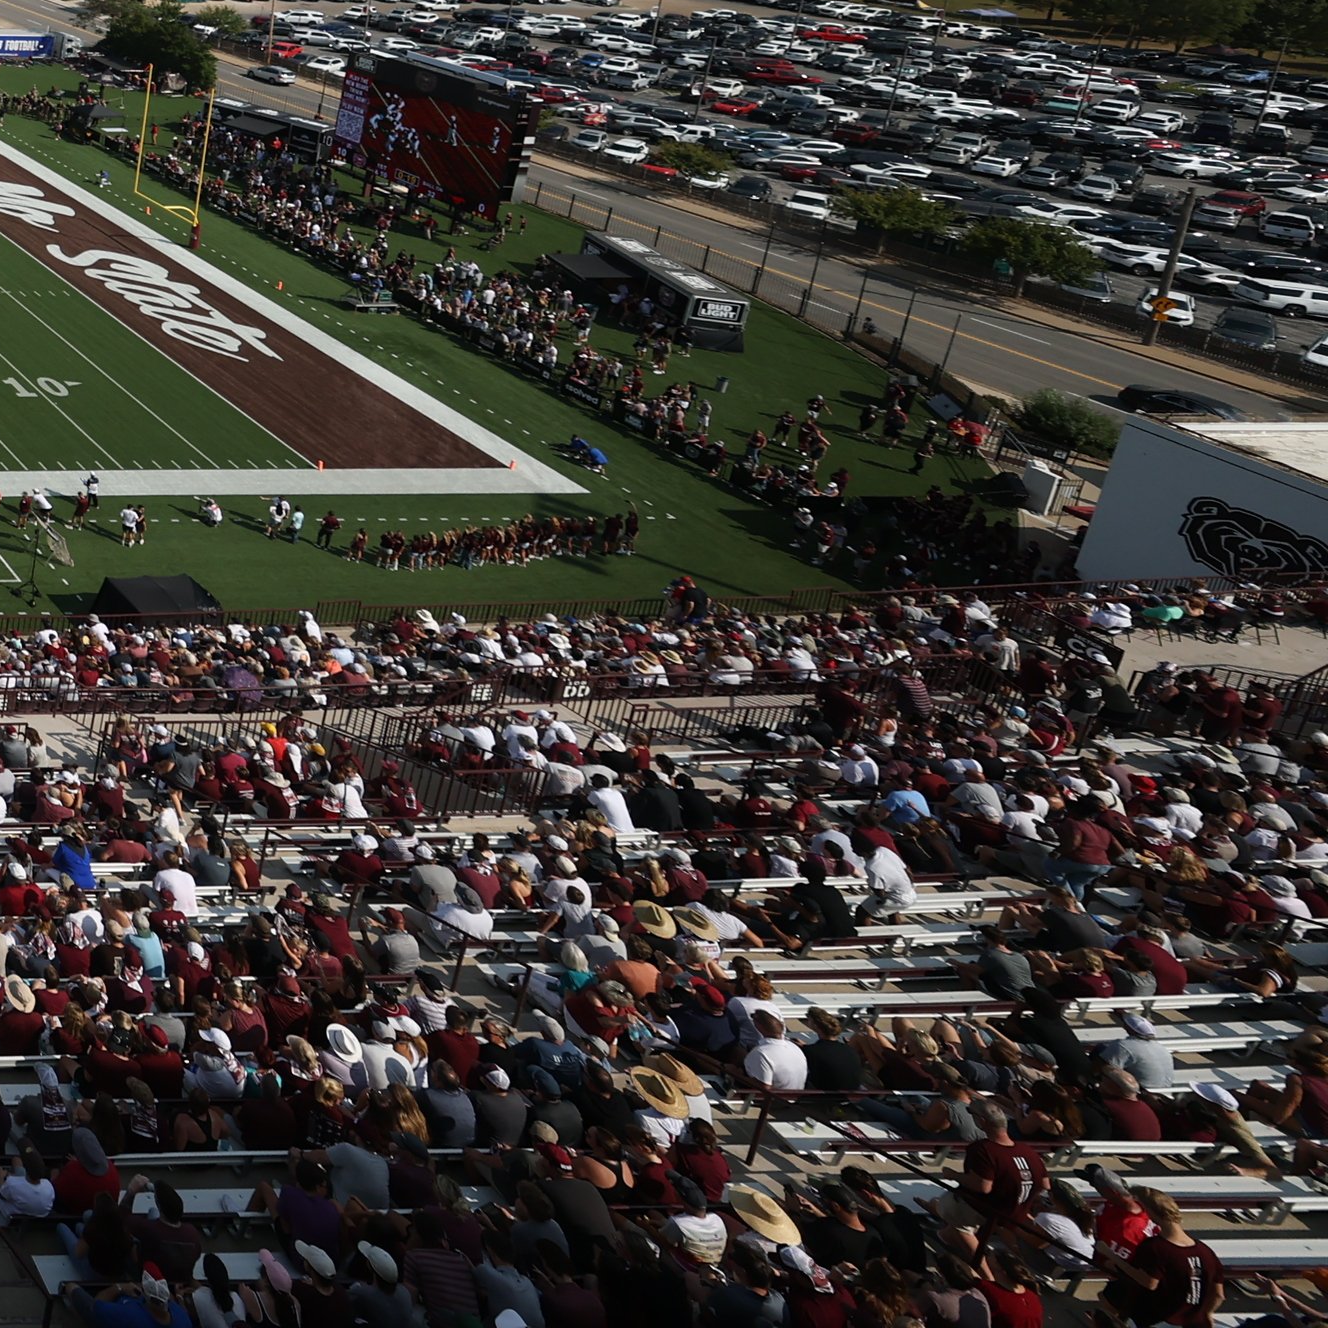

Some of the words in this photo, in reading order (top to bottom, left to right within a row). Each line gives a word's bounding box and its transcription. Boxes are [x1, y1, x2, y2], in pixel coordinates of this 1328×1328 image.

[4, 40, 39, 51] FOOTBALL
[322, 135, 333, 147] 10
[47, 242, 285, 364] State
[706, 302, 734, 313] BUD
[700, 309, 737, 320] LIGHT
[2, 377, 69, 399] 10
[562, 685, 591, 699] DD
